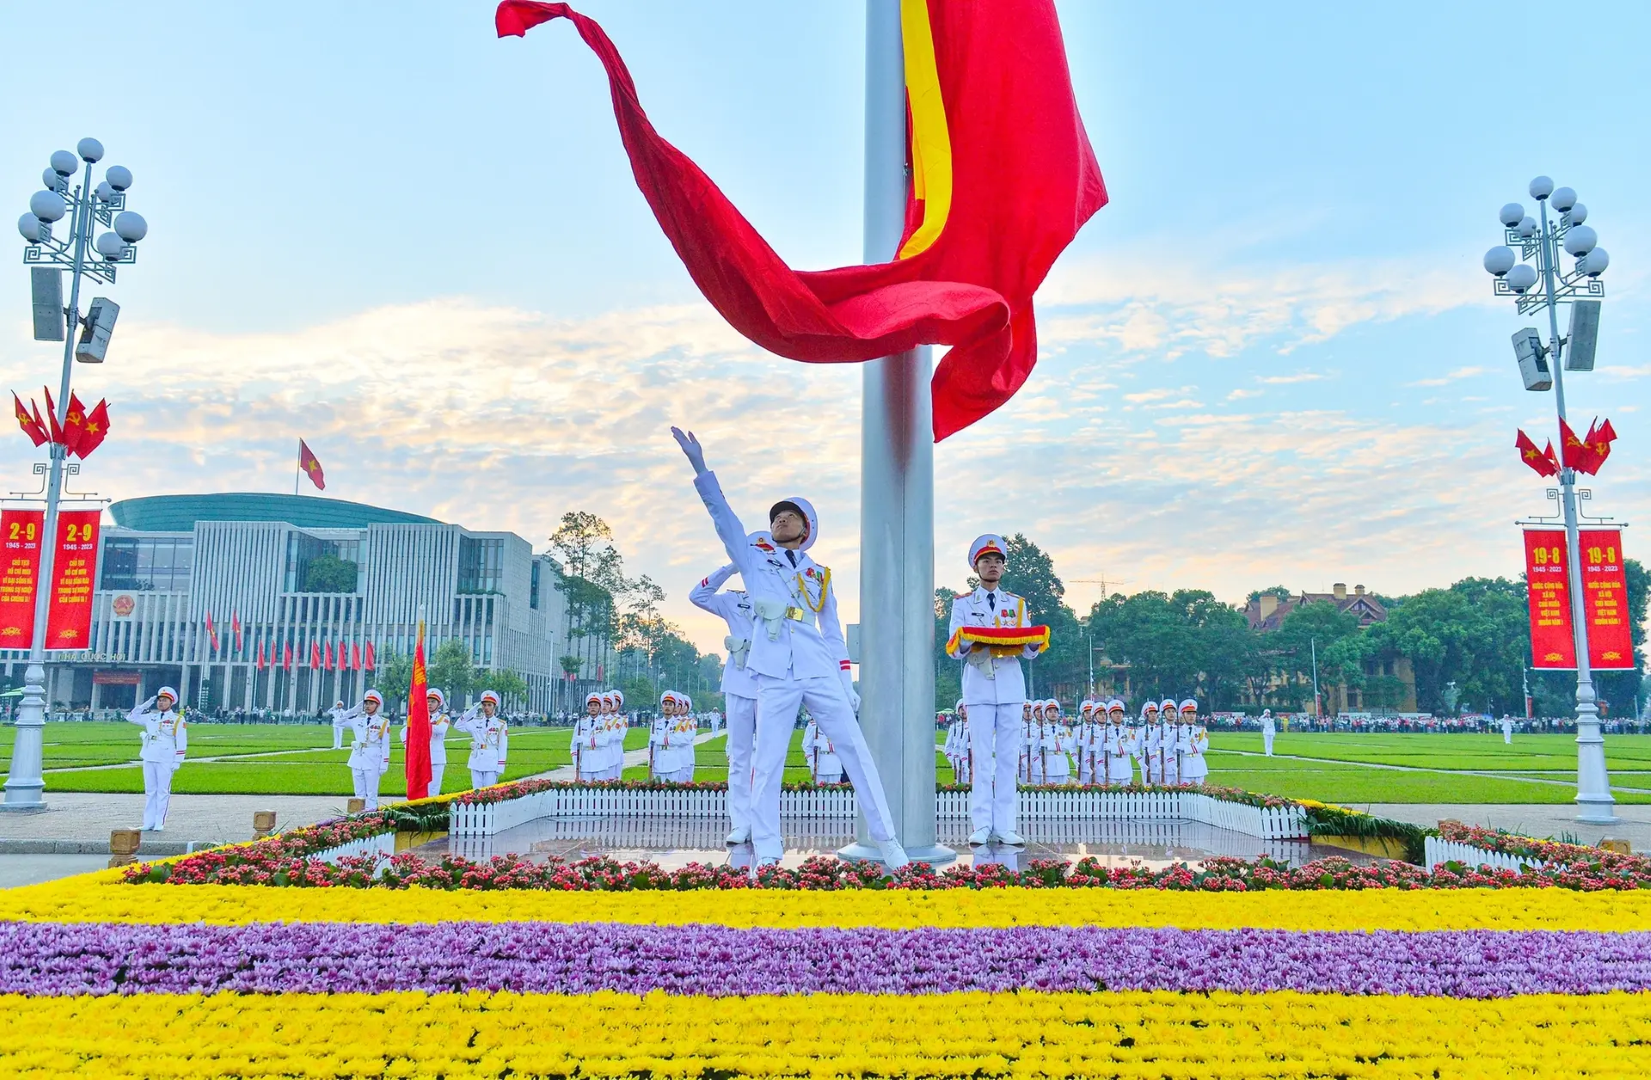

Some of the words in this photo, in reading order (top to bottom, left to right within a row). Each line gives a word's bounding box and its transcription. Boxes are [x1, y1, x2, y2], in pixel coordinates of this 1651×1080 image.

[10, 523, 35, 540] 2-9
[67, 524, 92, 541] 2-9
[1533, 547, 1559, 564] 19-8
[1588, 547, 1615, 563] 19-8
